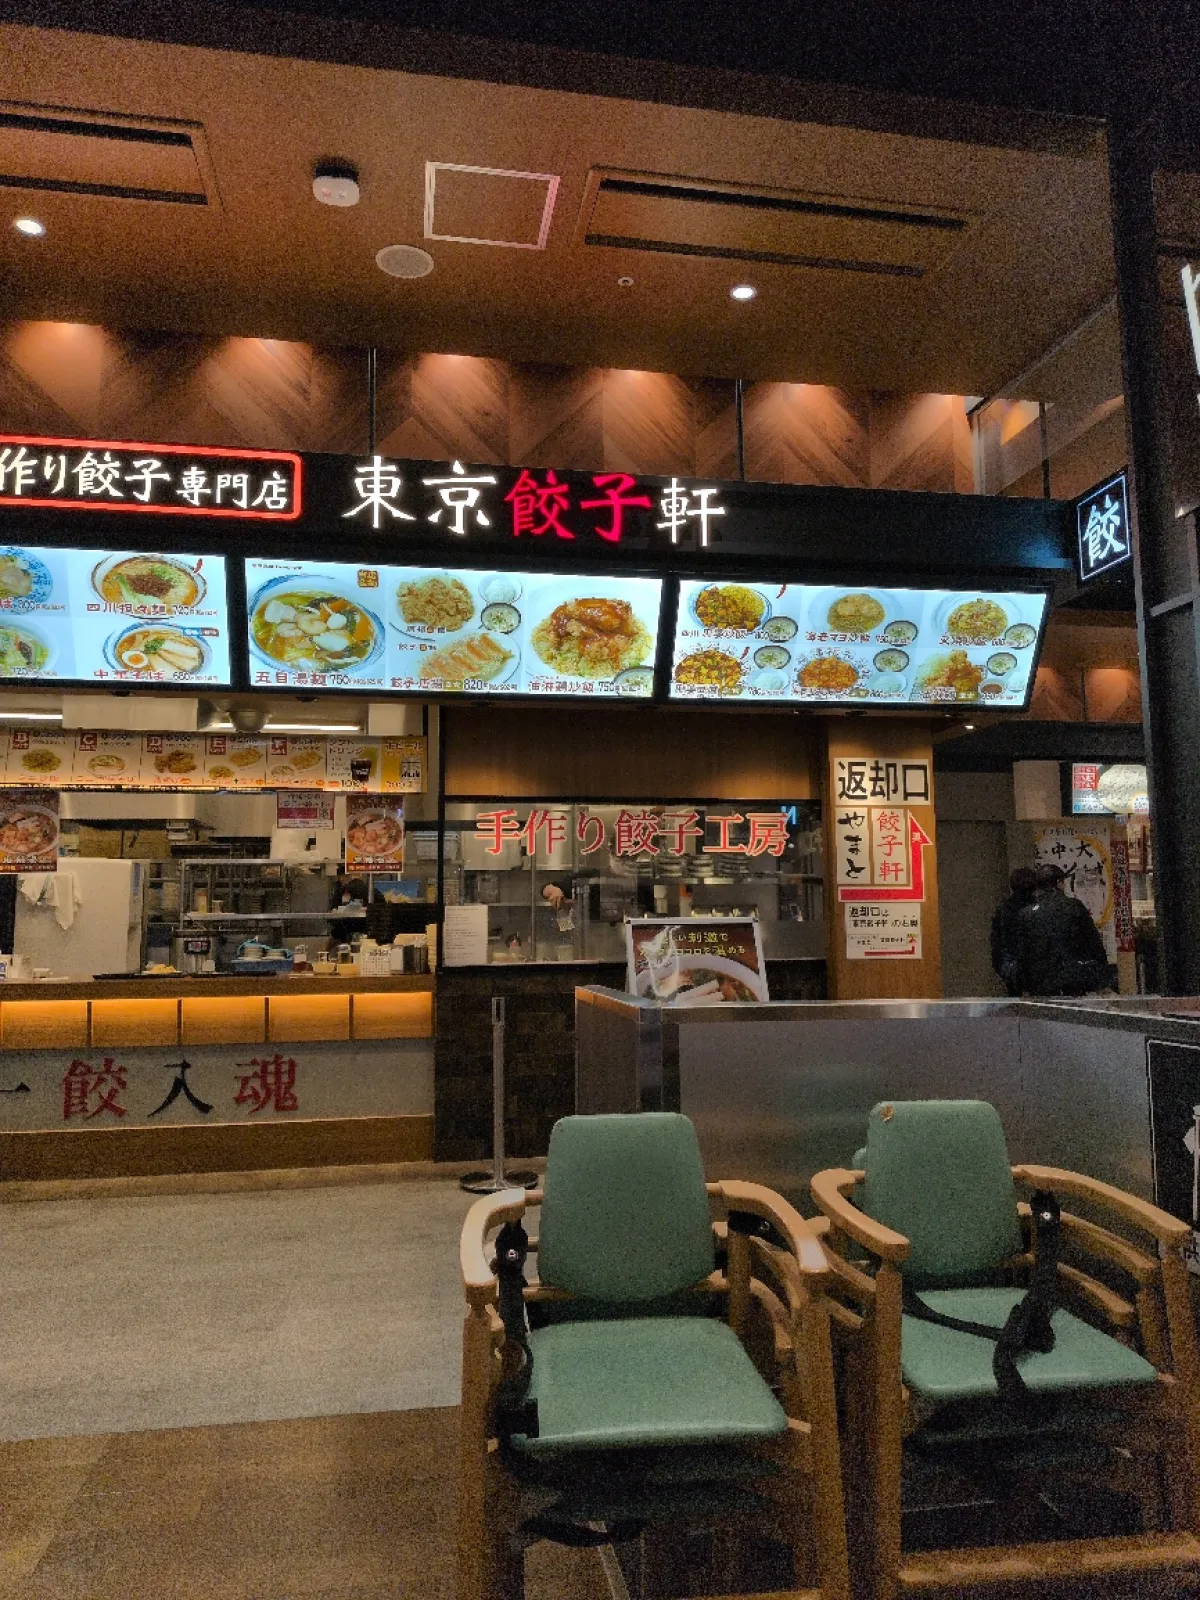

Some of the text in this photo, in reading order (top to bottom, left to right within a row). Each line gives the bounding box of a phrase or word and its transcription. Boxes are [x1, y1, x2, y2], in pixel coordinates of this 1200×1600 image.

[341, 454, 727, 547] 東京餃子軒
[1082, 494, 1126, 568] 餃
[838, 759, 929, 801] 返却口
[474, 808, 790, 856] 手作り餃子工房
[837, 811, 866, 879] やまと
[876, 810, 904, 882] 餃子軒
